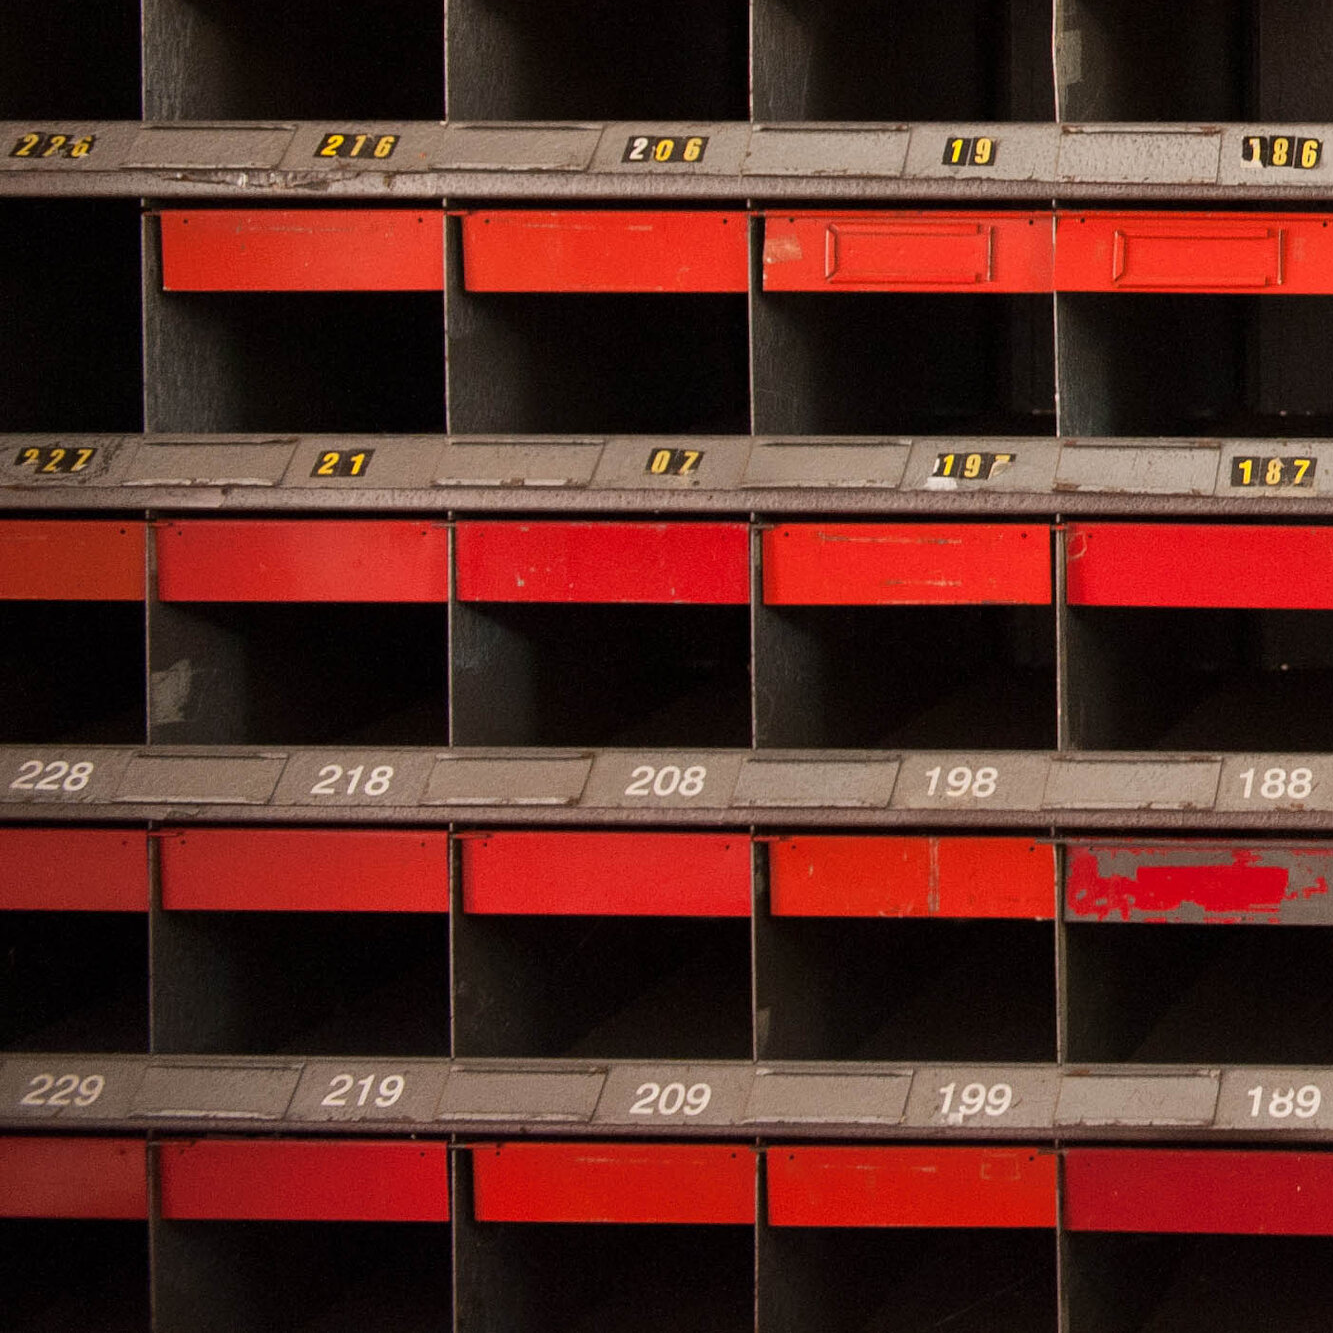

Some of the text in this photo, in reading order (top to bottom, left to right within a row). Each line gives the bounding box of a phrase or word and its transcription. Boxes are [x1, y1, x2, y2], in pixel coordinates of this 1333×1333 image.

[321, 134, 395, 158] 216
[629, 136, 704, 163] 206
[952, 136, 994, 164] 19
[1249, 138, 1318, 169] 186
[317, 452, 365, 475] 21
[1239, 458, 1311, 487] 187
[9, 759, 95, 794] 228
[310, 764, 395, 798] 218
[624, 765, 707, 798] 208
[924, 765, 999, 798] 198
[1237, 767, 1314, 800] 188
[20, 1072, 105, 1107] 229
[320, 1074, 405, 1109] 219
[628, 1082, 712, 1116] 209
[938, 1083, 1013, 1117] 199
[1245, 1084, 1322, 1119] 189
